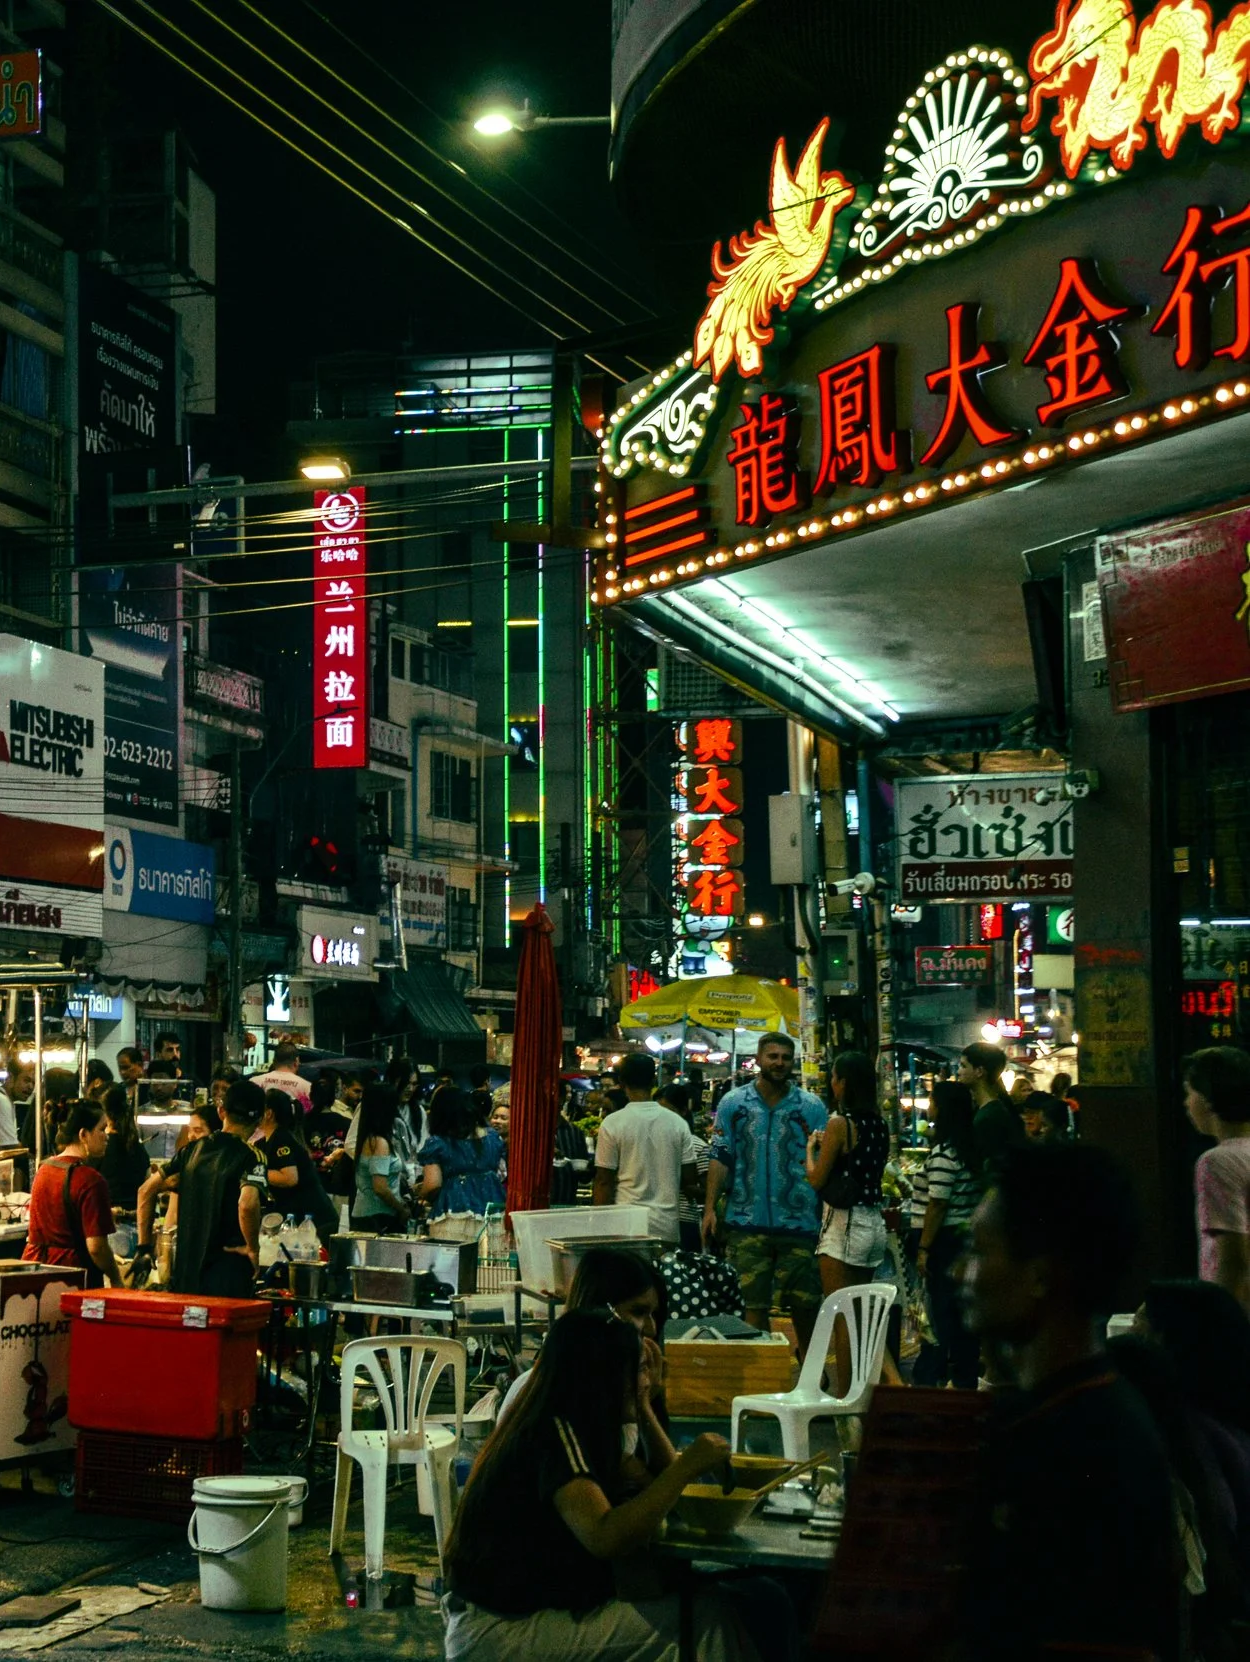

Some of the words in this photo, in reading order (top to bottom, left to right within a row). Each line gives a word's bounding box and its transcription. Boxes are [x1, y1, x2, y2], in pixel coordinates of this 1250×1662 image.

[324, 580, 356, 748] 兰州拉面
[10, 699, 94, 749] MITSUBISHI
[10, 733, 84, 778] ELECTRIC
[104, 736, 173, 771] 02-623-2212
[690, 718, 740, 916] 興大金行
[139, 868, 212, 901] ธนาคารทิสโก้
[698, 1008, 741, 1018] EMPOWER
[710, 1016, 735, 1025] YOUR
